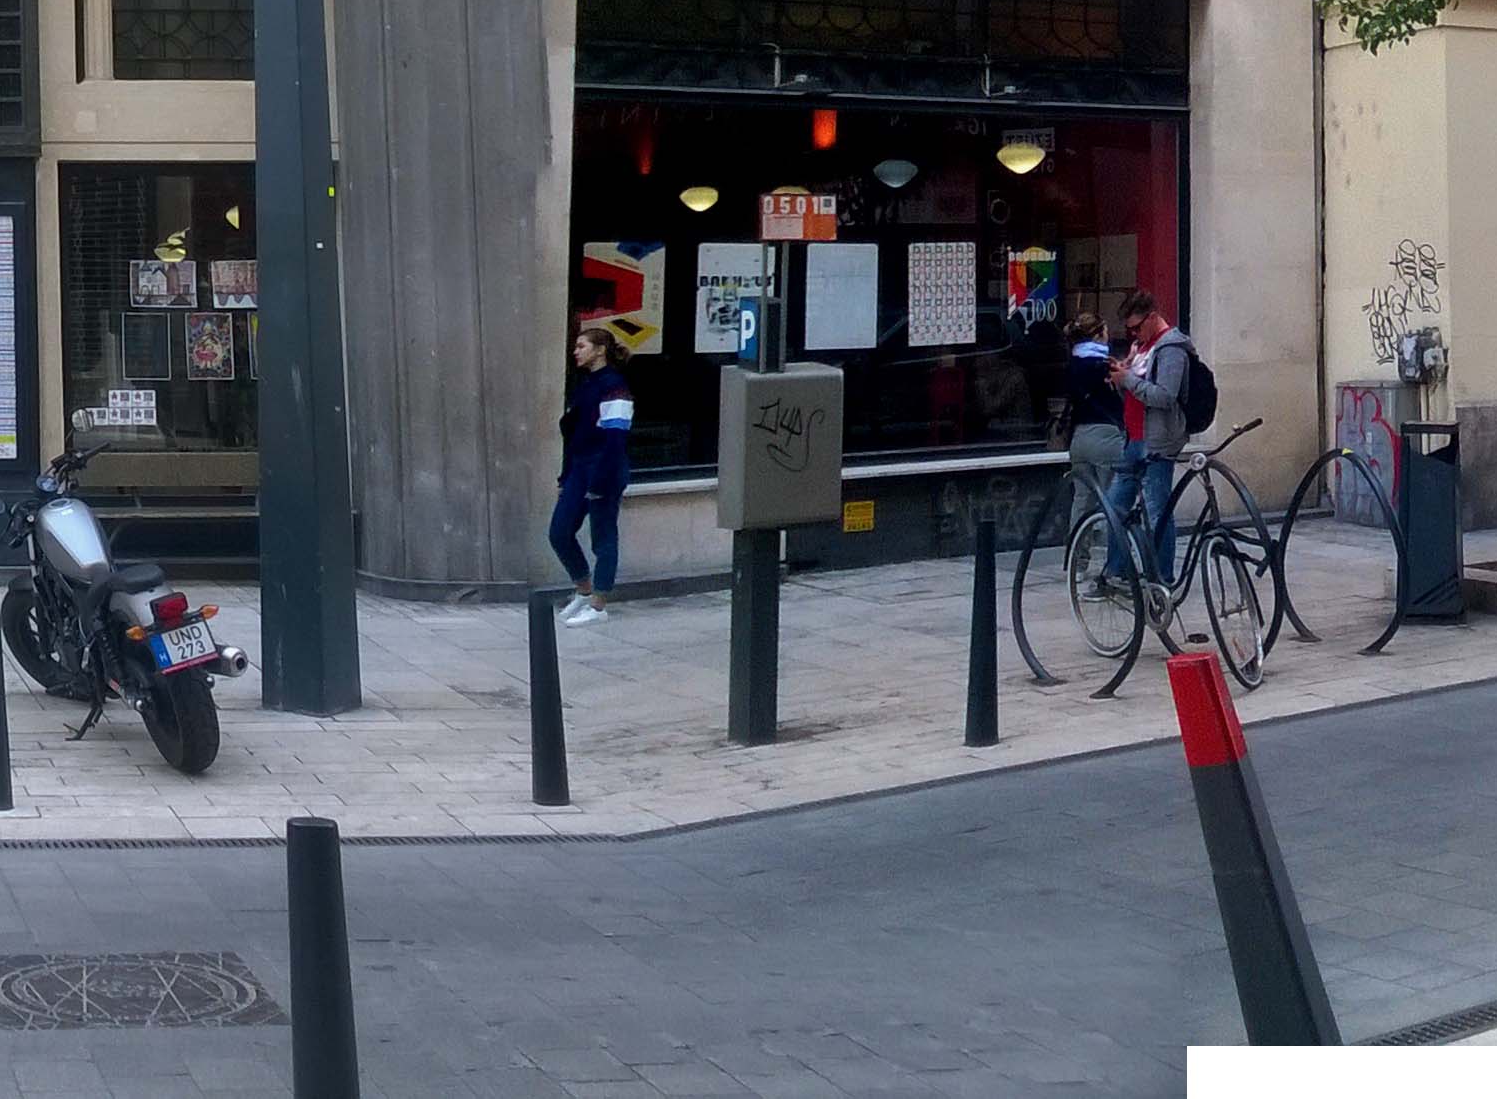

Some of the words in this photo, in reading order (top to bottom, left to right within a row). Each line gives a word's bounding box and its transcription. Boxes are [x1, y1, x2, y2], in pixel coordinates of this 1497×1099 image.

[741, 311, 756, 351] P
[168, 625, 202, 646] UND
[177, 640, 205, 660] 273
